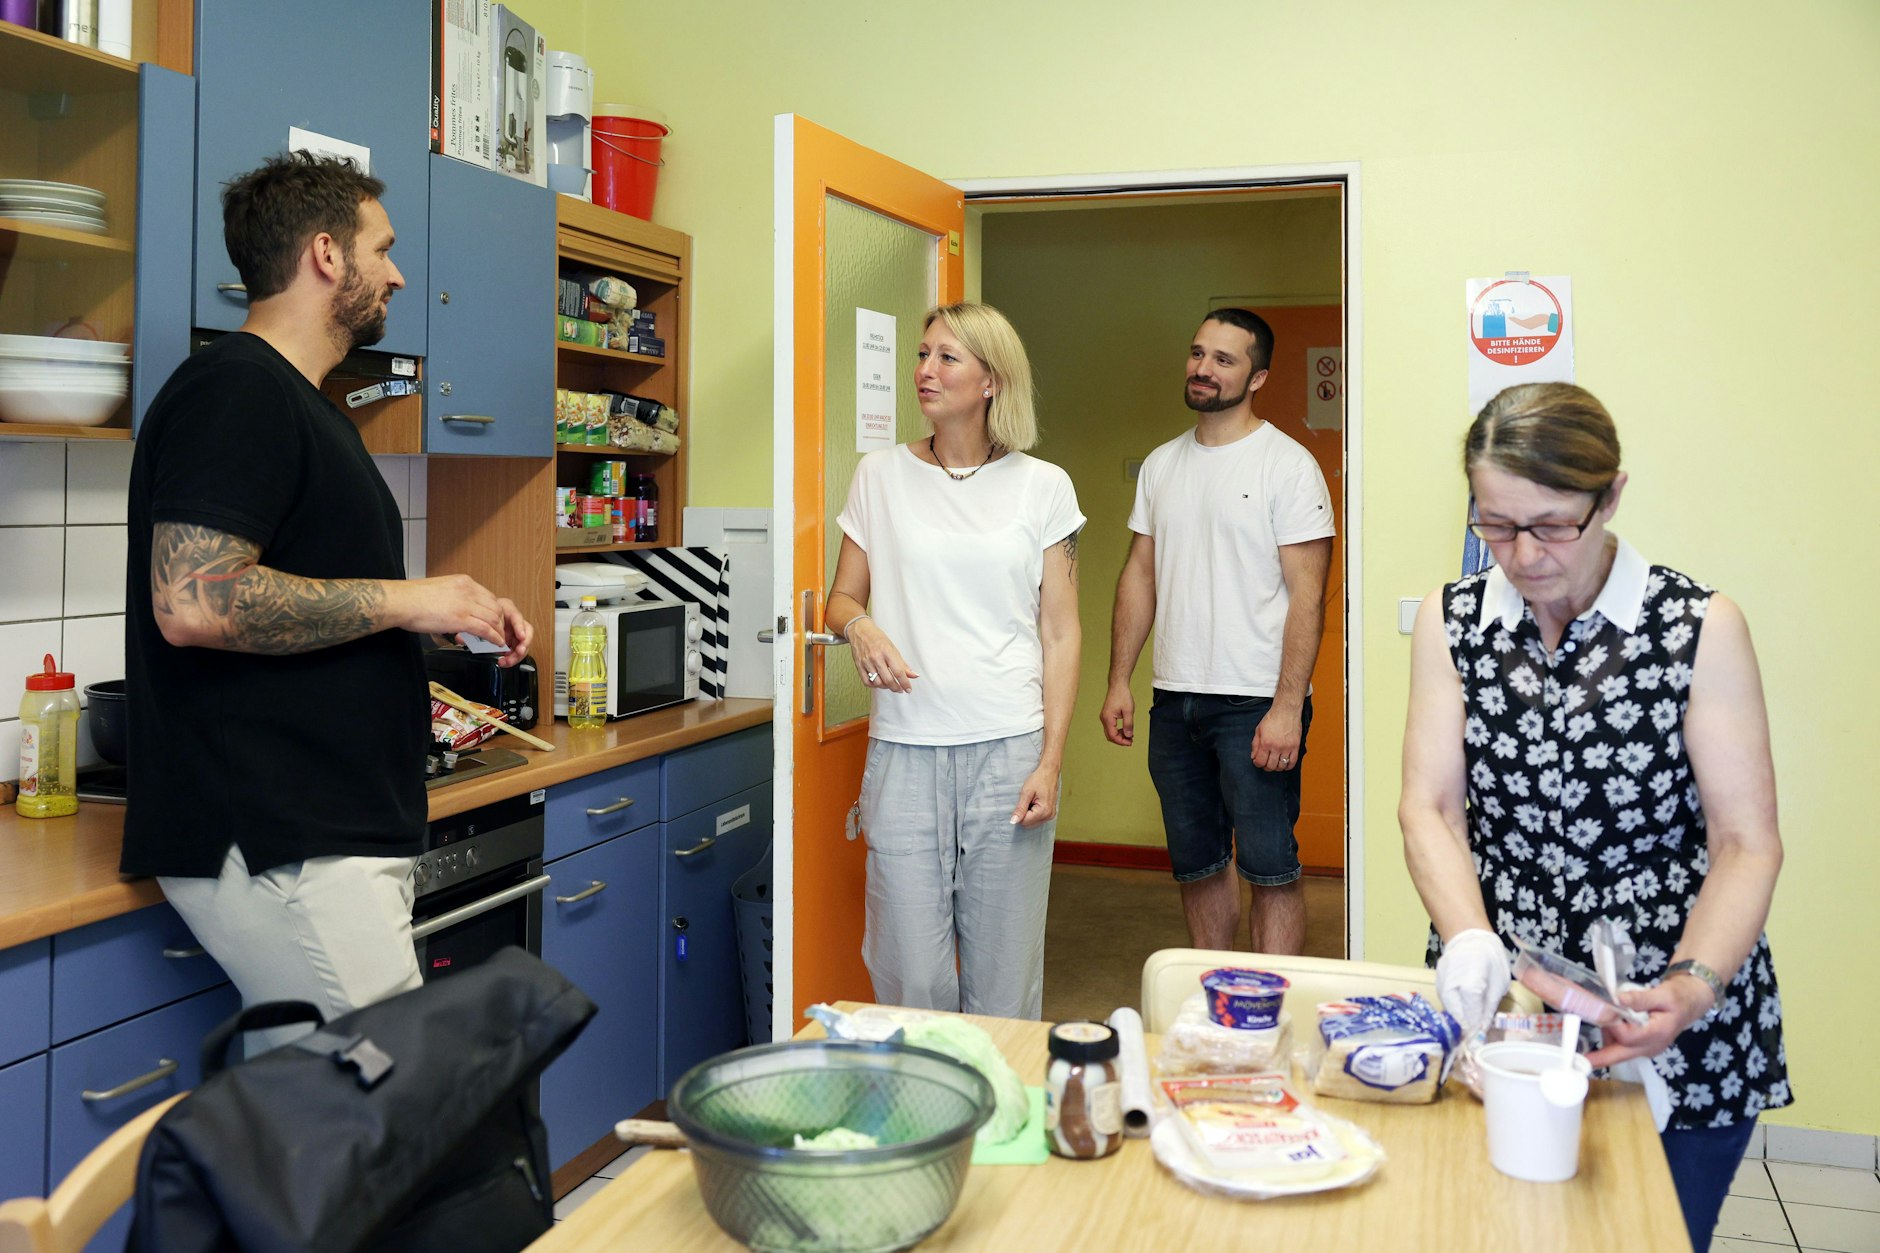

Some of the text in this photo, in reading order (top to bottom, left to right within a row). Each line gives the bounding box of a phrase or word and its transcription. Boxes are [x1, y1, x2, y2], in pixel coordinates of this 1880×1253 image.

[432, 95, 440, 128] Quality
[1490, 337, 1541, 347] BITTE HÄNDE
[1487, 346, 1544, 354] DESINFIZIEREN
[1514, 355, 1518, 363] !
